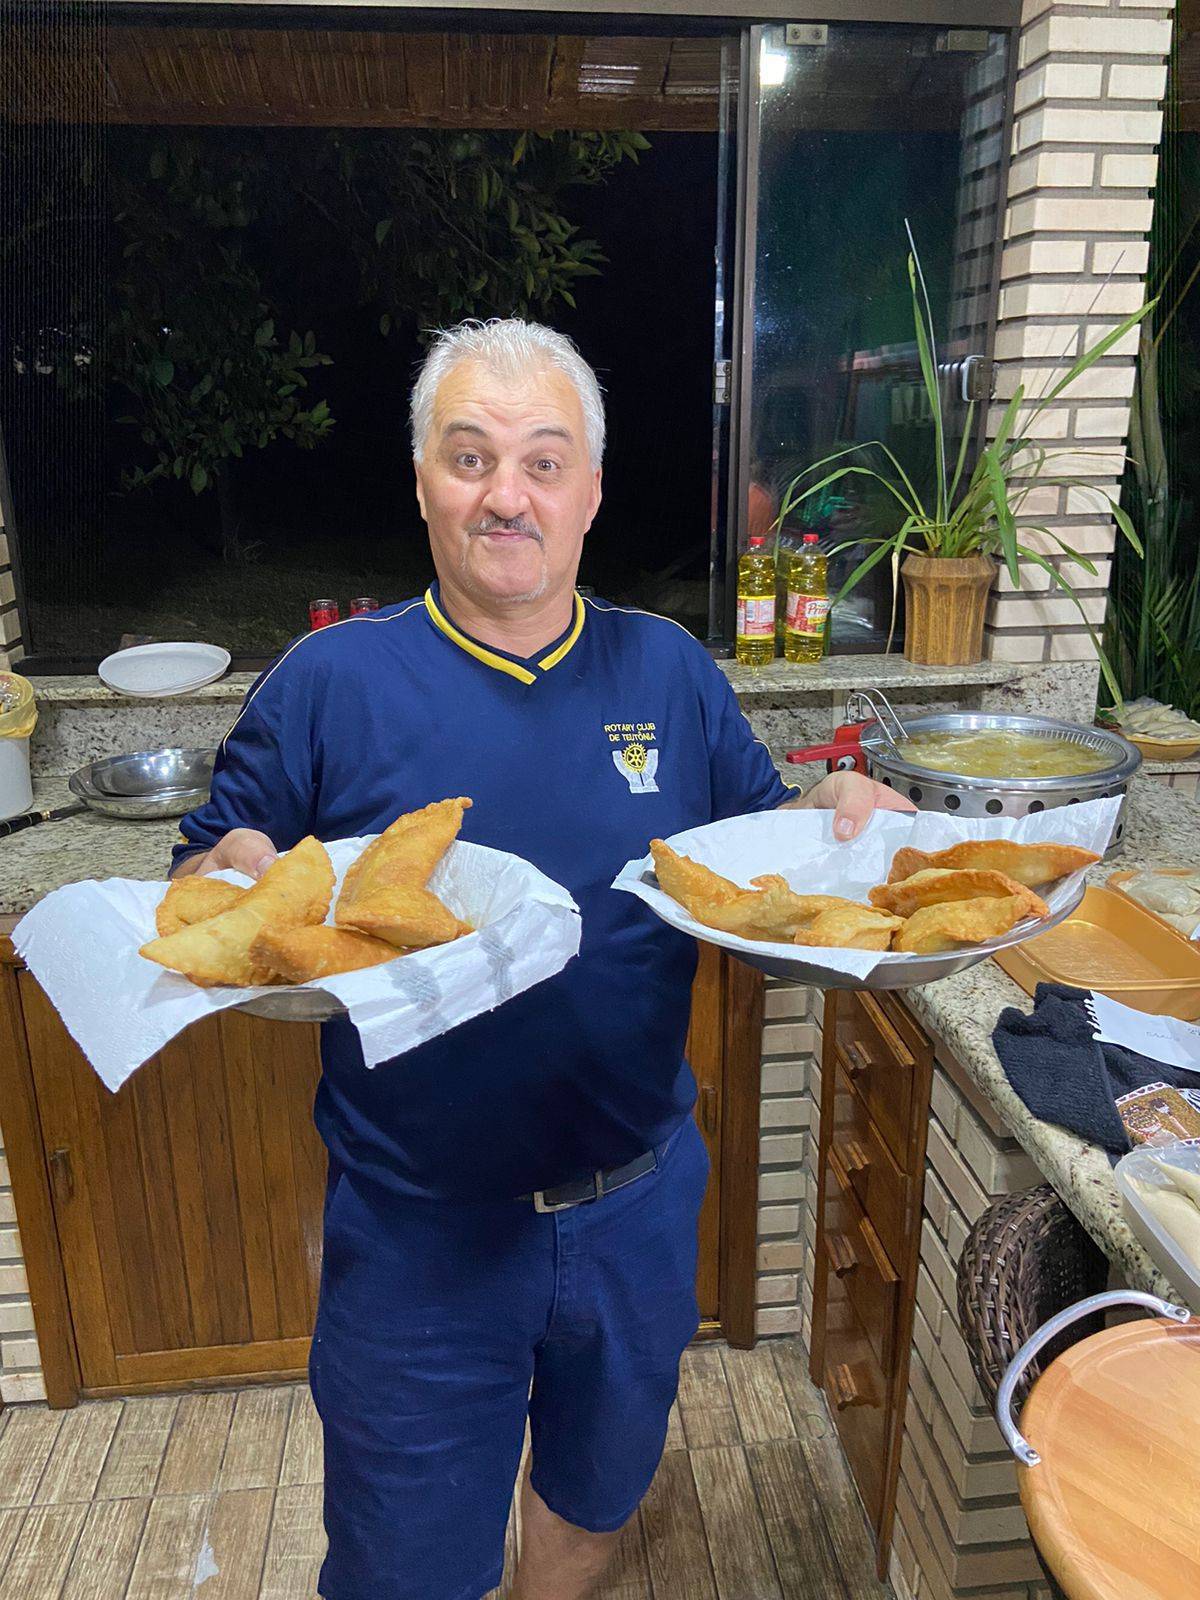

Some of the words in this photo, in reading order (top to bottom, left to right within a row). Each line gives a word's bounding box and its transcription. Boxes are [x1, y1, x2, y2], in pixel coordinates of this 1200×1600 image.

[604, 723, 635, 732] ROTARY
[636, 723, 656, 731] CLUB
[608, 733, 620, 742] DE
[622, 731, 656, 741] TEUTÔNIA
